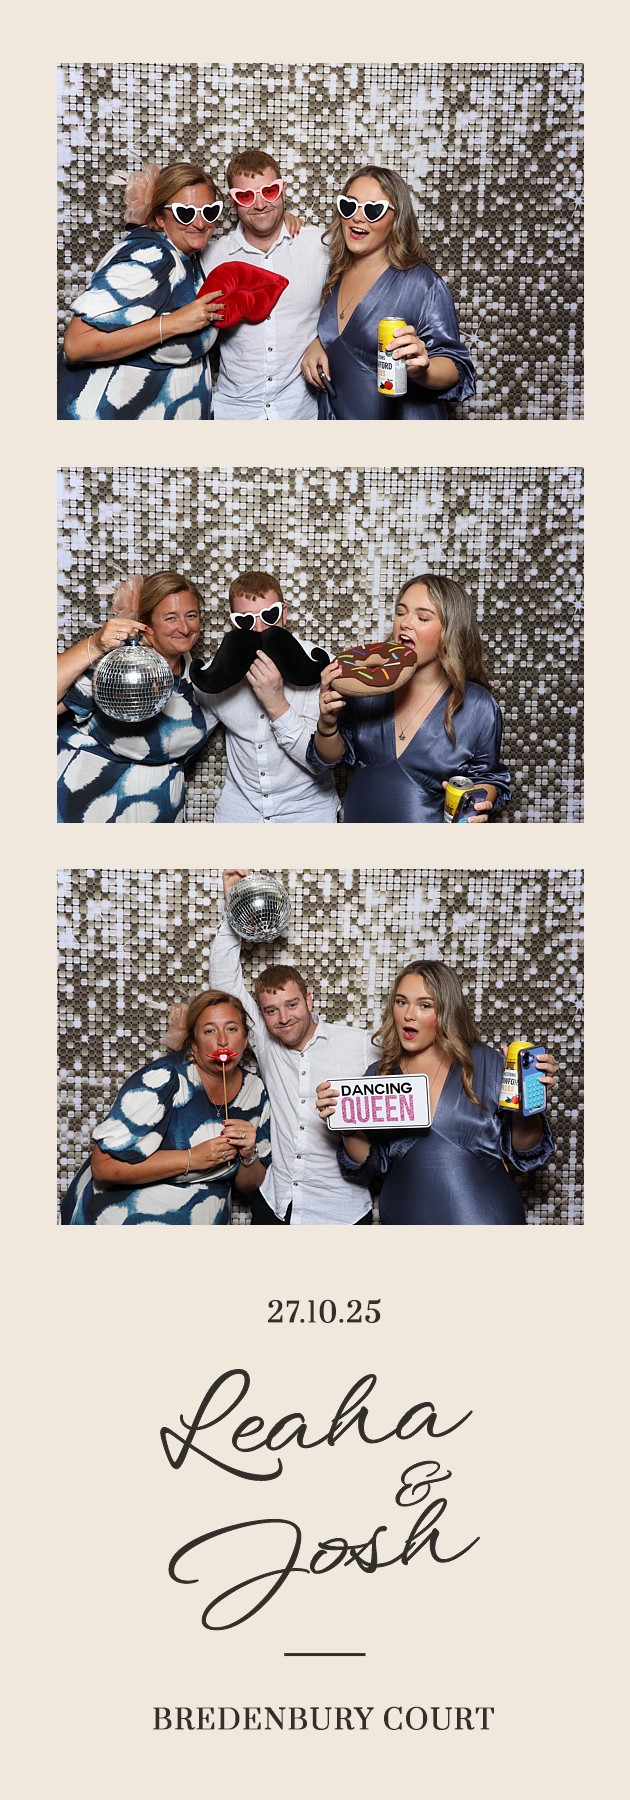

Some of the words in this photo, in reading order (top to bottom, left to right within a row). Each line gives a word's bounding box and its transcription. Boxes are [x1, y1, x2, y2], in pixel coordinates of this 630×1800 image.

[377, 361, 393, 370] FORD
[341, 1082, 413, 1096] DANCING
[341, 1094, 415, 1125] QUEEN
